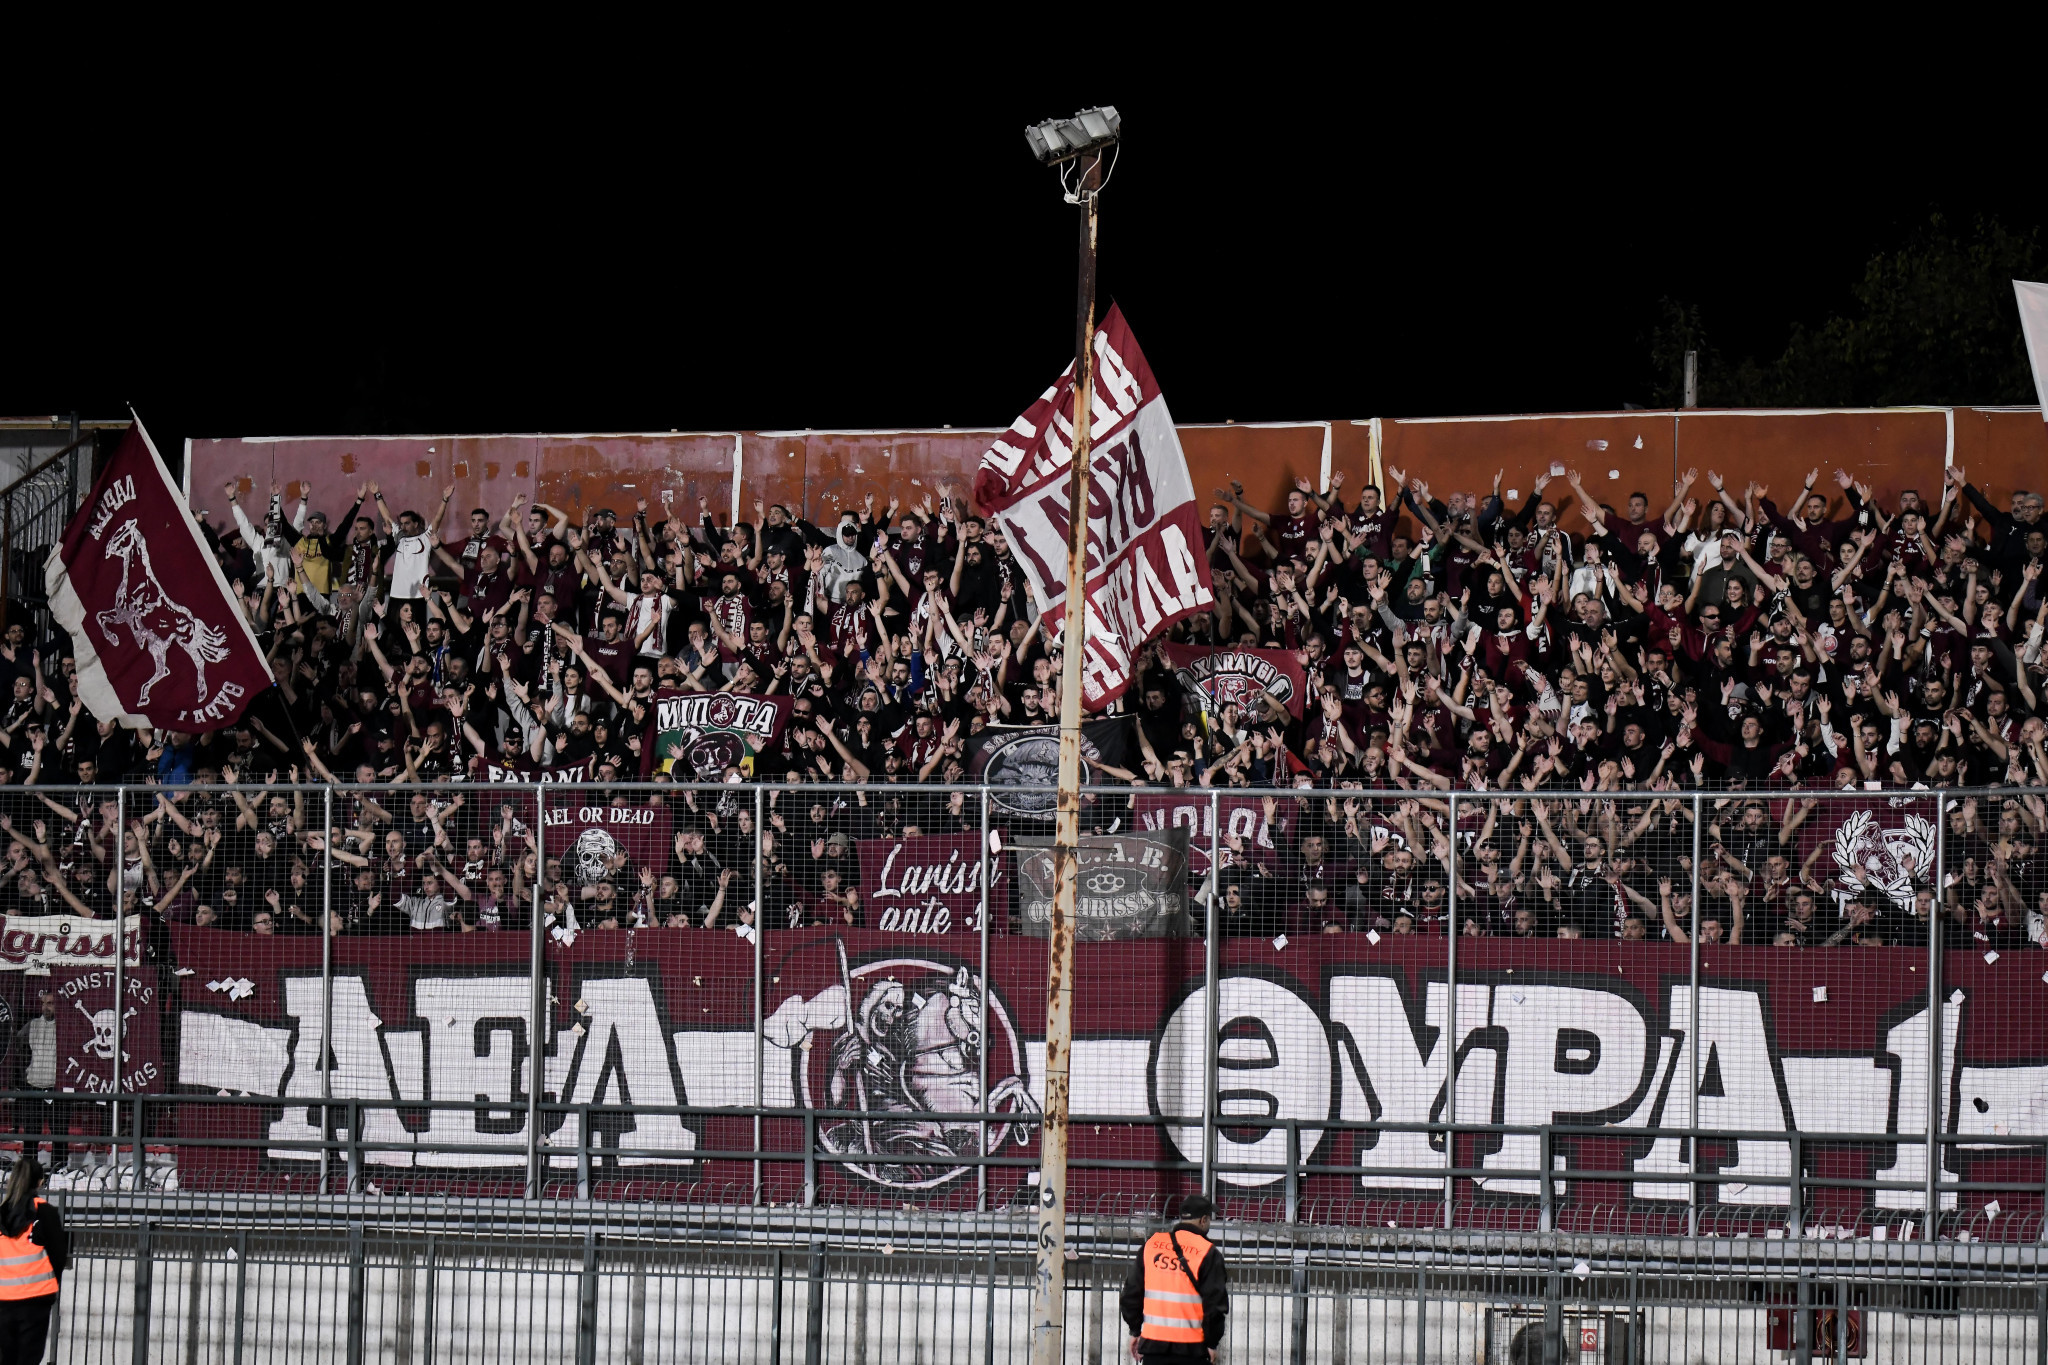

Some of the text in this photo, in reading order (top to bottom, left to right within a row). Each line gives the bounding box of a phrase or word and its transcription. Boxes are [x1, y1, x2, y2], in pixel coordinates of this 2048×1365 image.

[1191, 652, 1278, 686] XARAVGI
[578, 807, 603, 823] OR
[609, 808, 655, 825] DEAD
[1075, 890, 1156, 918] ARISSA
[1156, 893, 1181, 916] 12
[58, 972, 153, 1004] MONSTRS
[65, 1056, 157, 1094] TIRNVOS
[1153, 1240, 1202, 1256] SECRITY
